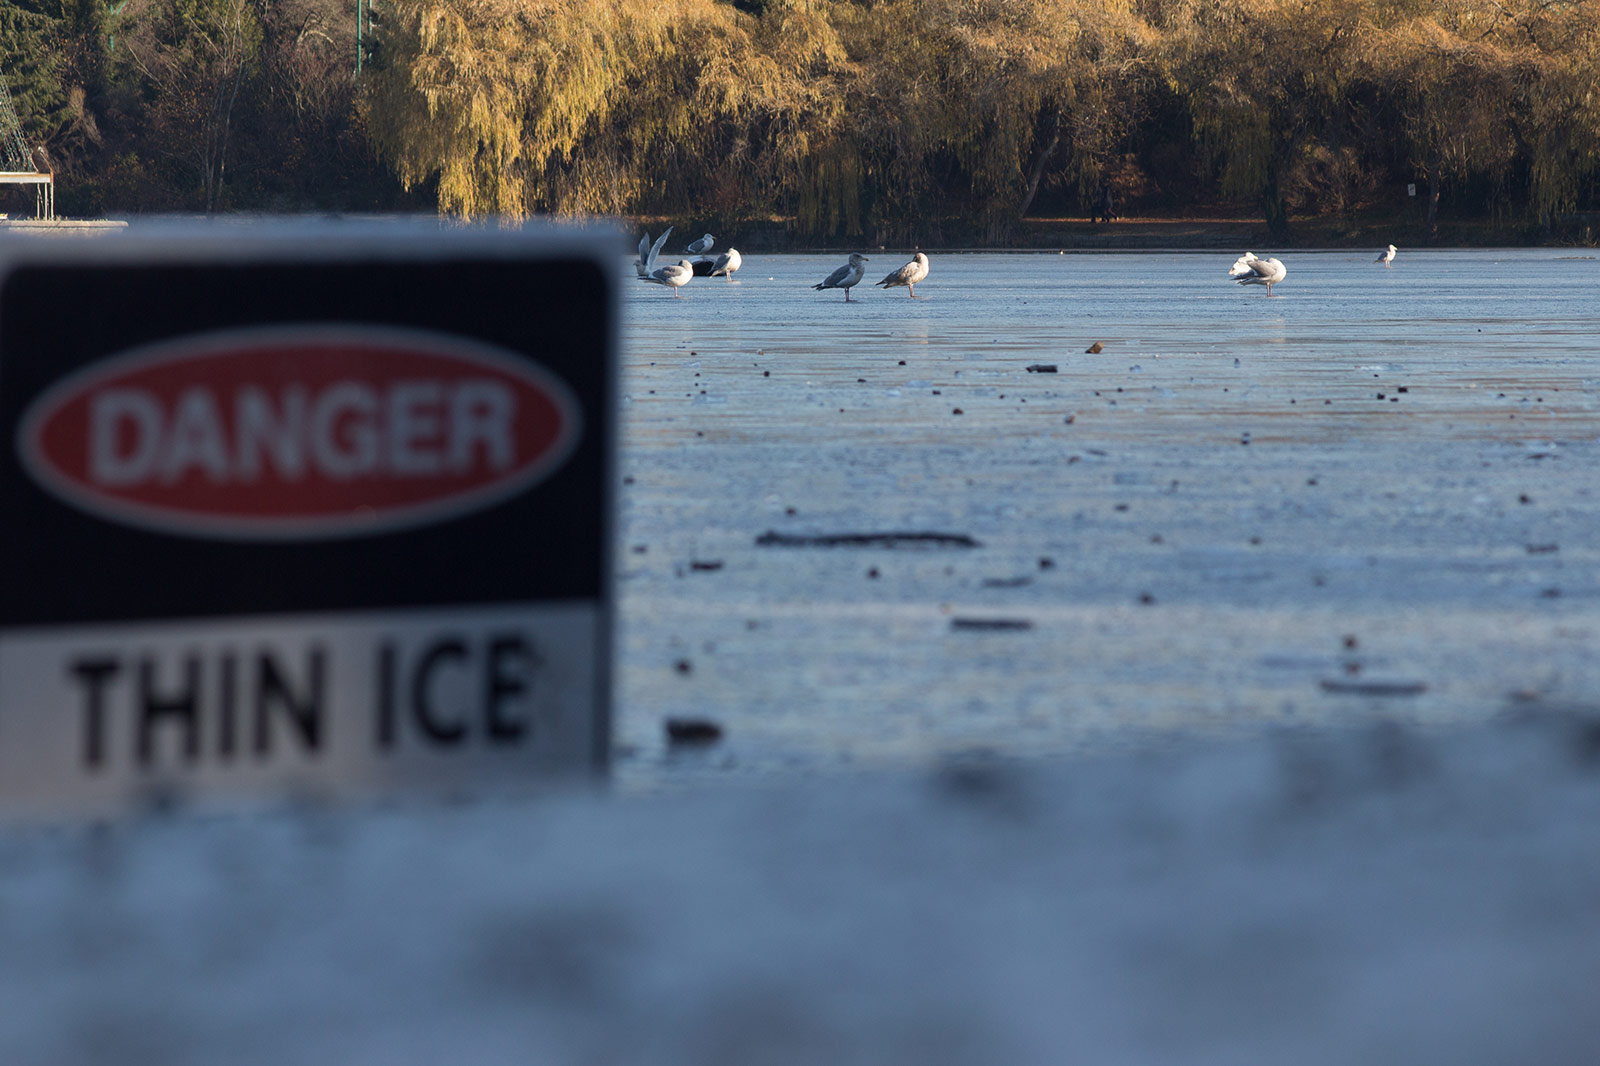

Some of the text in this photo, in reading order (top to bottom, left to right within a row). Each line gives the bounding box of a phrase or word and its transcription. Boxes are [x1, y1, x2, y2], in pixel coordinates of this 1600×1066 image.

[88, 379, 517, 487] DANGER
[69, 634, 534, 773] THIN ICE
